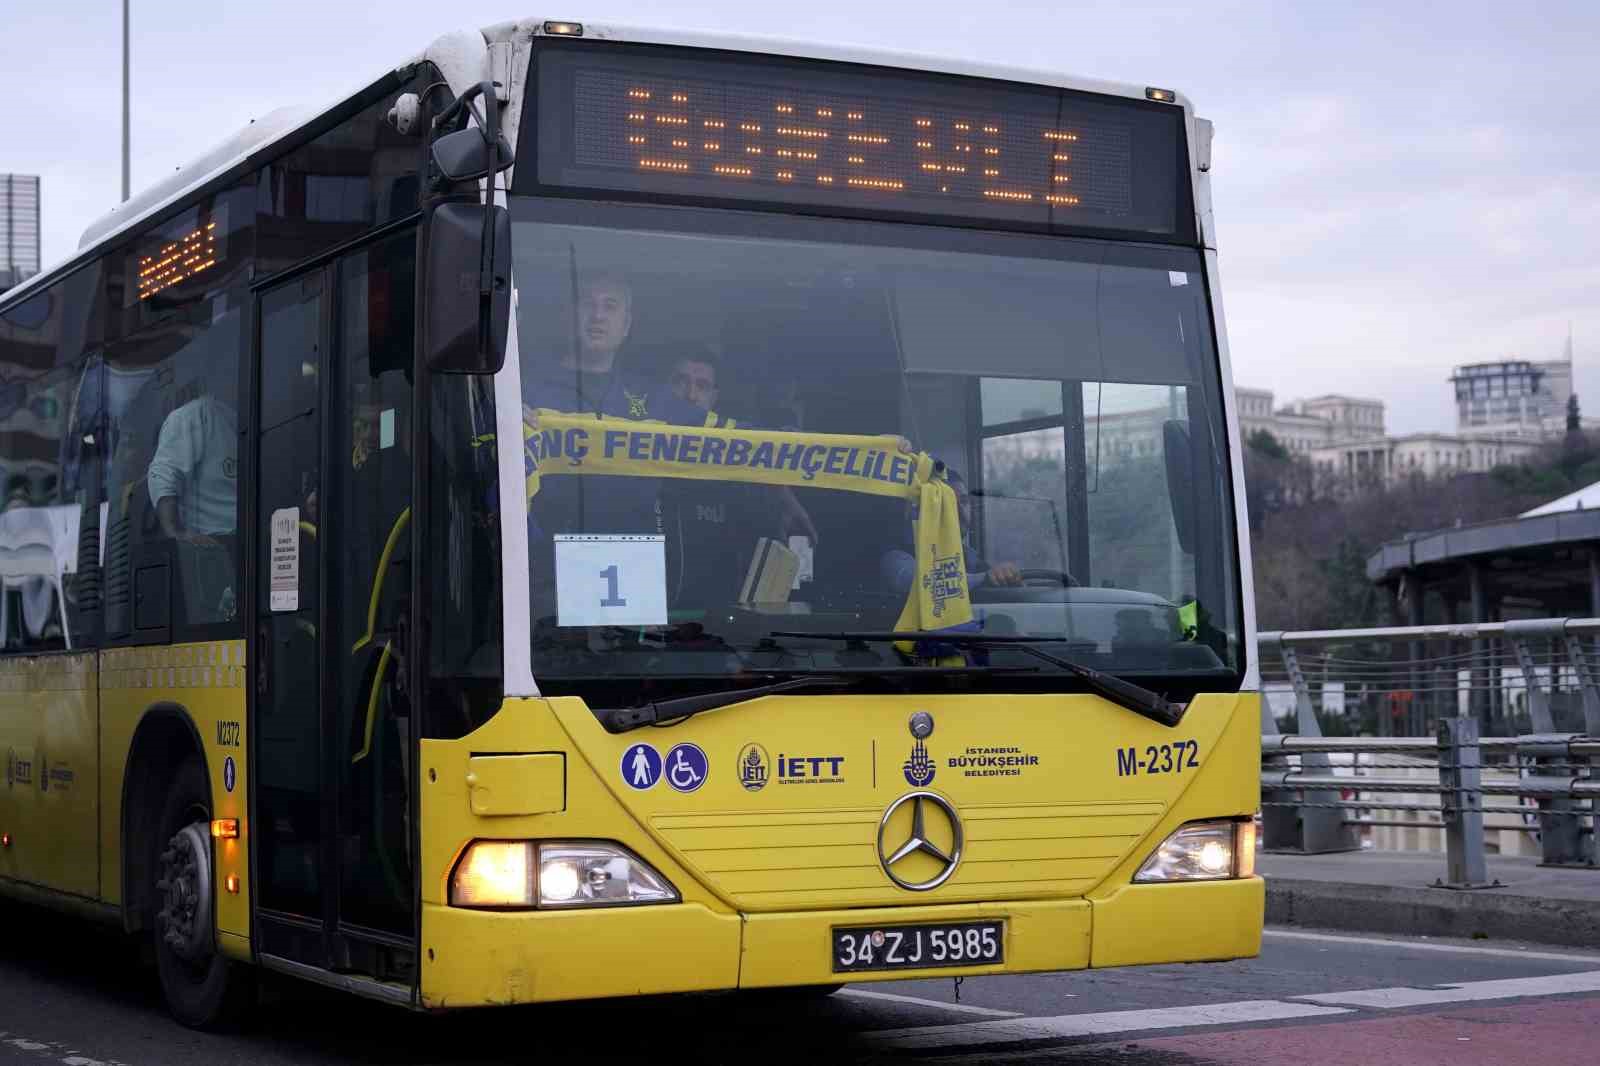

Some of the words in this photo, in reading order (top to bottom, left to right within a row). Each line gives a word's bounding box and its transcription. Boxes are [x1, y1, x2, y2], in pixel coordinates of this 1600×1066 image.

[598, 565, 627, 607] 1
[217, 720, 240, 747] M2372
[948, 753, 1039, 768] BÜYÜKŞEHİR
[966, 746, 1021, 755] İSTANBUL
[1117, 739, 1199, 777] M-2372
[840, 934, 874, 966] 34
[885, 931, 923, 963] ZJ
[930, 928, 997, 961] 5985
